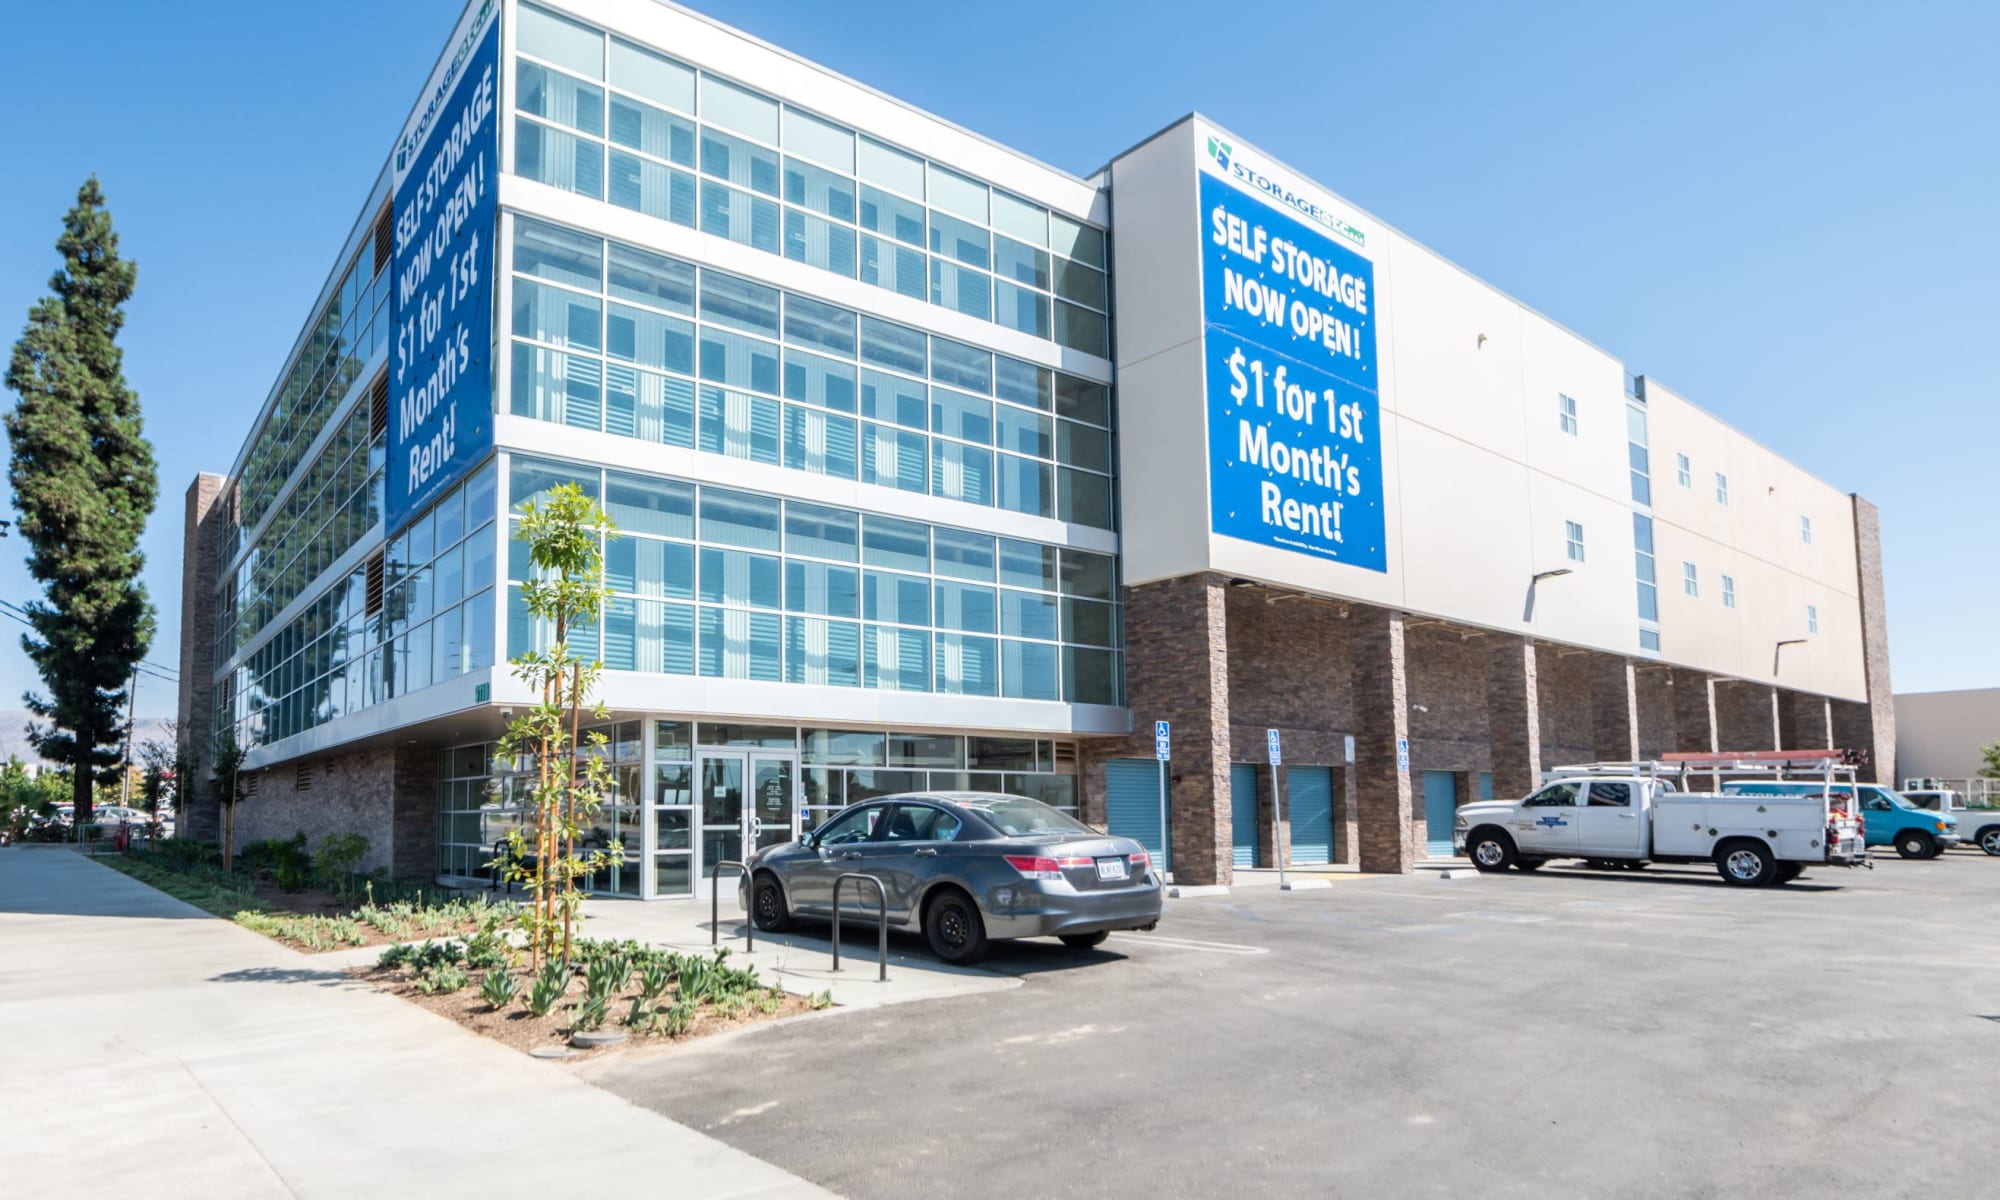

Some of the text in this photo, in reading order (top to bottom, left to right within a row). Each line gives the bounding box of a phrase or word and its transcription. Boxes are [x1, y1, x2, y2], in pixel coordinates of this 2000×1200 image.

[396, 64, 492, 259] SELF STORAGE
[399, 152, 484, 312] NOW OPEN!
[1212, 206, 1367, 315] SELF STORAGE
[397, 233, 479, 385] $1 for 1st
[1224, 268, 1361, 360] NOW OPEN!
[399, 321, 469, 446] Month's
[1229, 347, 1363, 444] $1 for 1st
[1239, 420, 1361, 496] Month's
